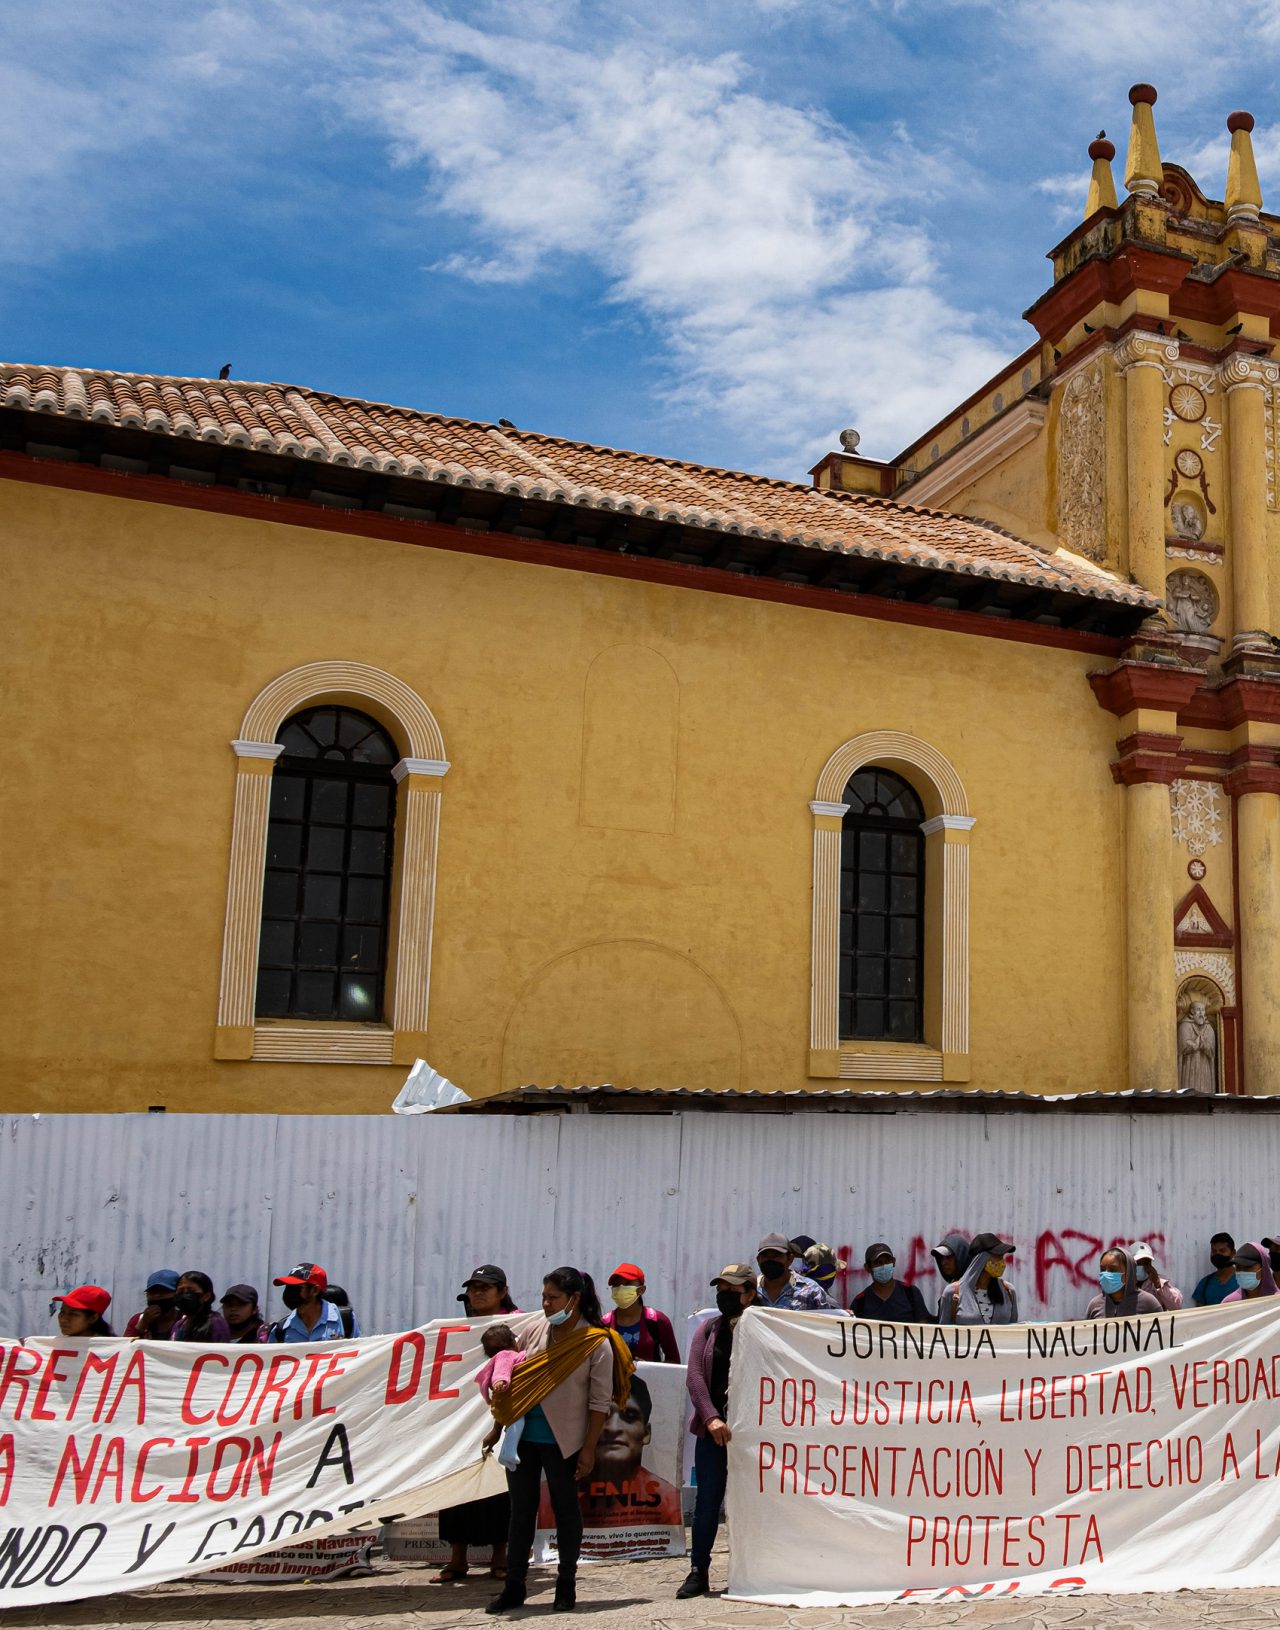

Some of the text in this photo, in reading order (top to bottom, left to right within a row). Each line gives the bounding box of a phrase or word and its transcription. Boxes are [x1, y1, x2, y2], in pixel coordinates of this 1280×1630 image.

[827, 1315, 1184, 1360] JORNADA NACIONAL
[0, 1326, 471, 1427] REMA CORTE DE
[758, 1376, 817, 1427] POR
[830, 1378, 983, 1429] JUSTICIA,
[999, 1366, 1157, 1423] LIBERTAD,
[48, 1431, 283, 1508] NACION
[306, 1423, 355, 1488] A
[590, 1479, 662, 1508] FNLS
[758, 1439, 1004, 1498] PRESENTACIÓN
[1025, 1448, 1044, 1496] Y
[1065, 1434, 1204, 1495] DERECHO
[1220, 1432, 1242, 1481] A
[0, 1522, 108, 1590] NDO
[122, 1521, 177, 1576] Y
[906, 1513, 1105, 1567] PROTESTA
